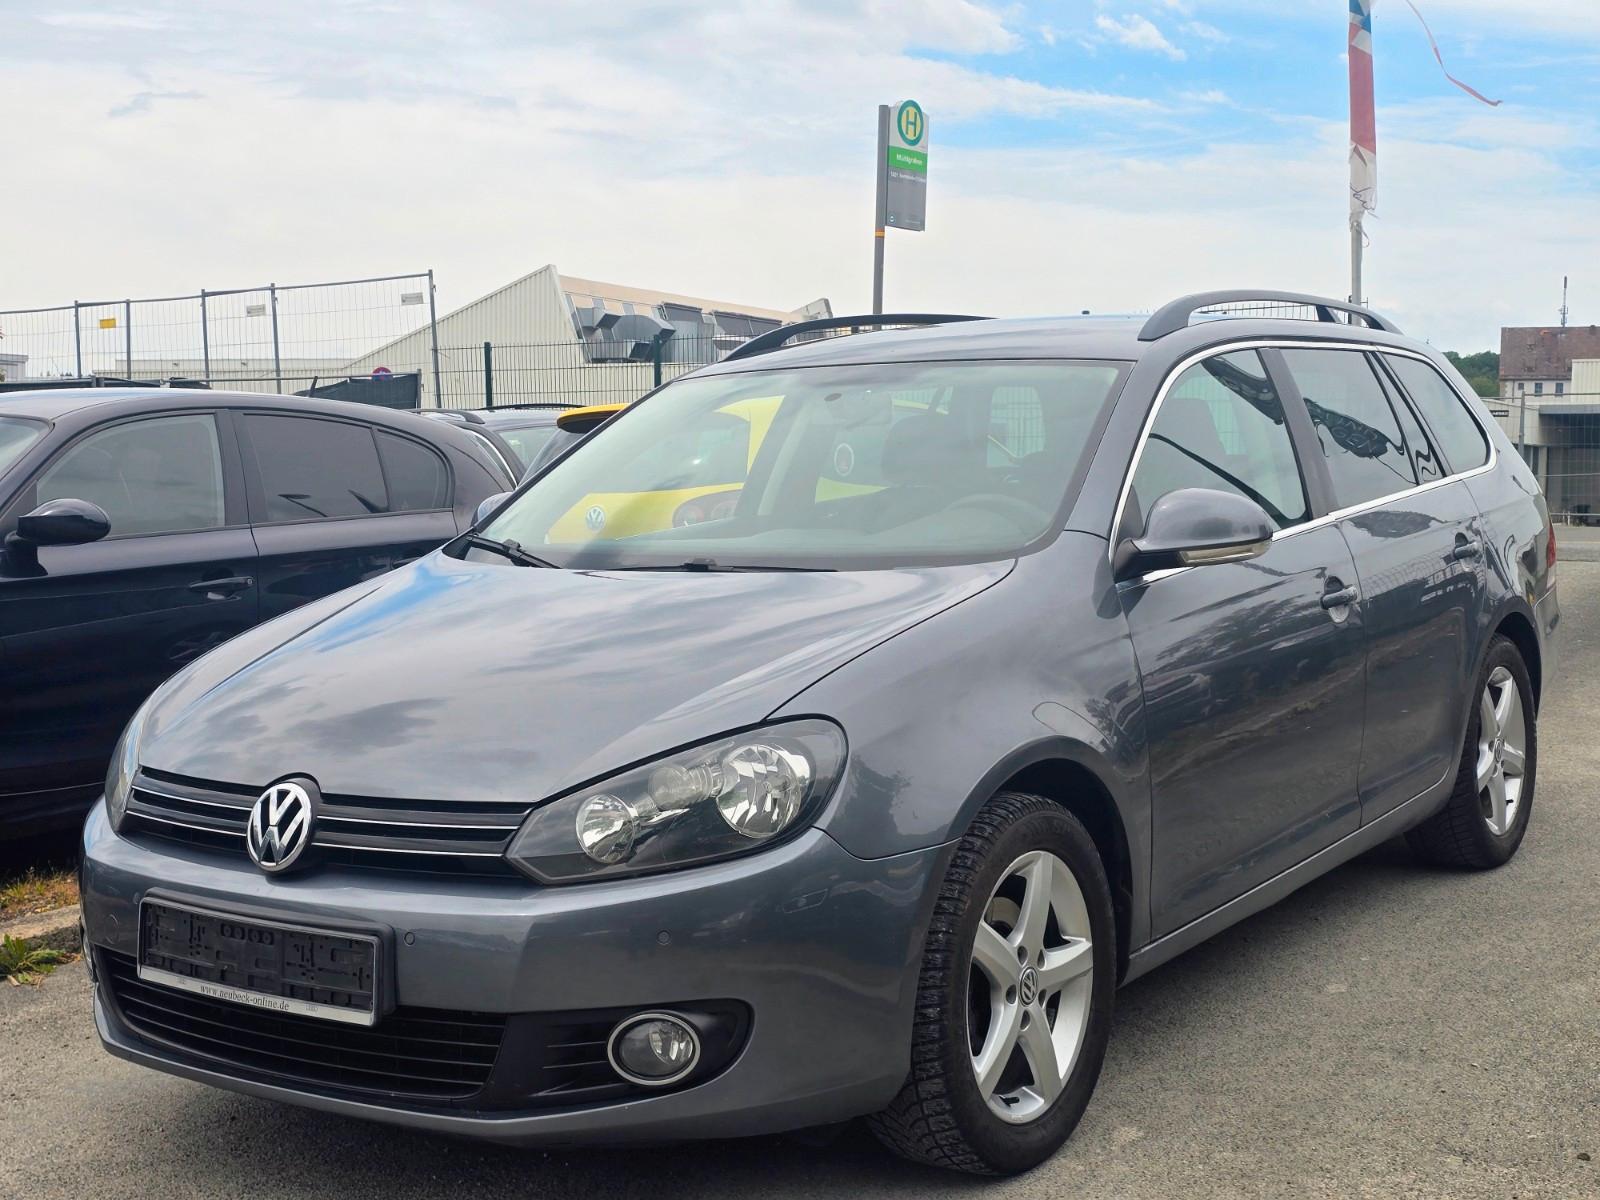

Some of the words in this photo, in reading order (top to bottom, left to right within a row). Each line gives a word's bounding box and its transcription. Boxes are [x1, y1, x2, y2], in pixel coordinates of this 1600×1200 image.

[905, 109, 918, 138] H
[248, 783, 312, 870] VW
[200, 984, 289, 1011] www.neubeck-online.de
